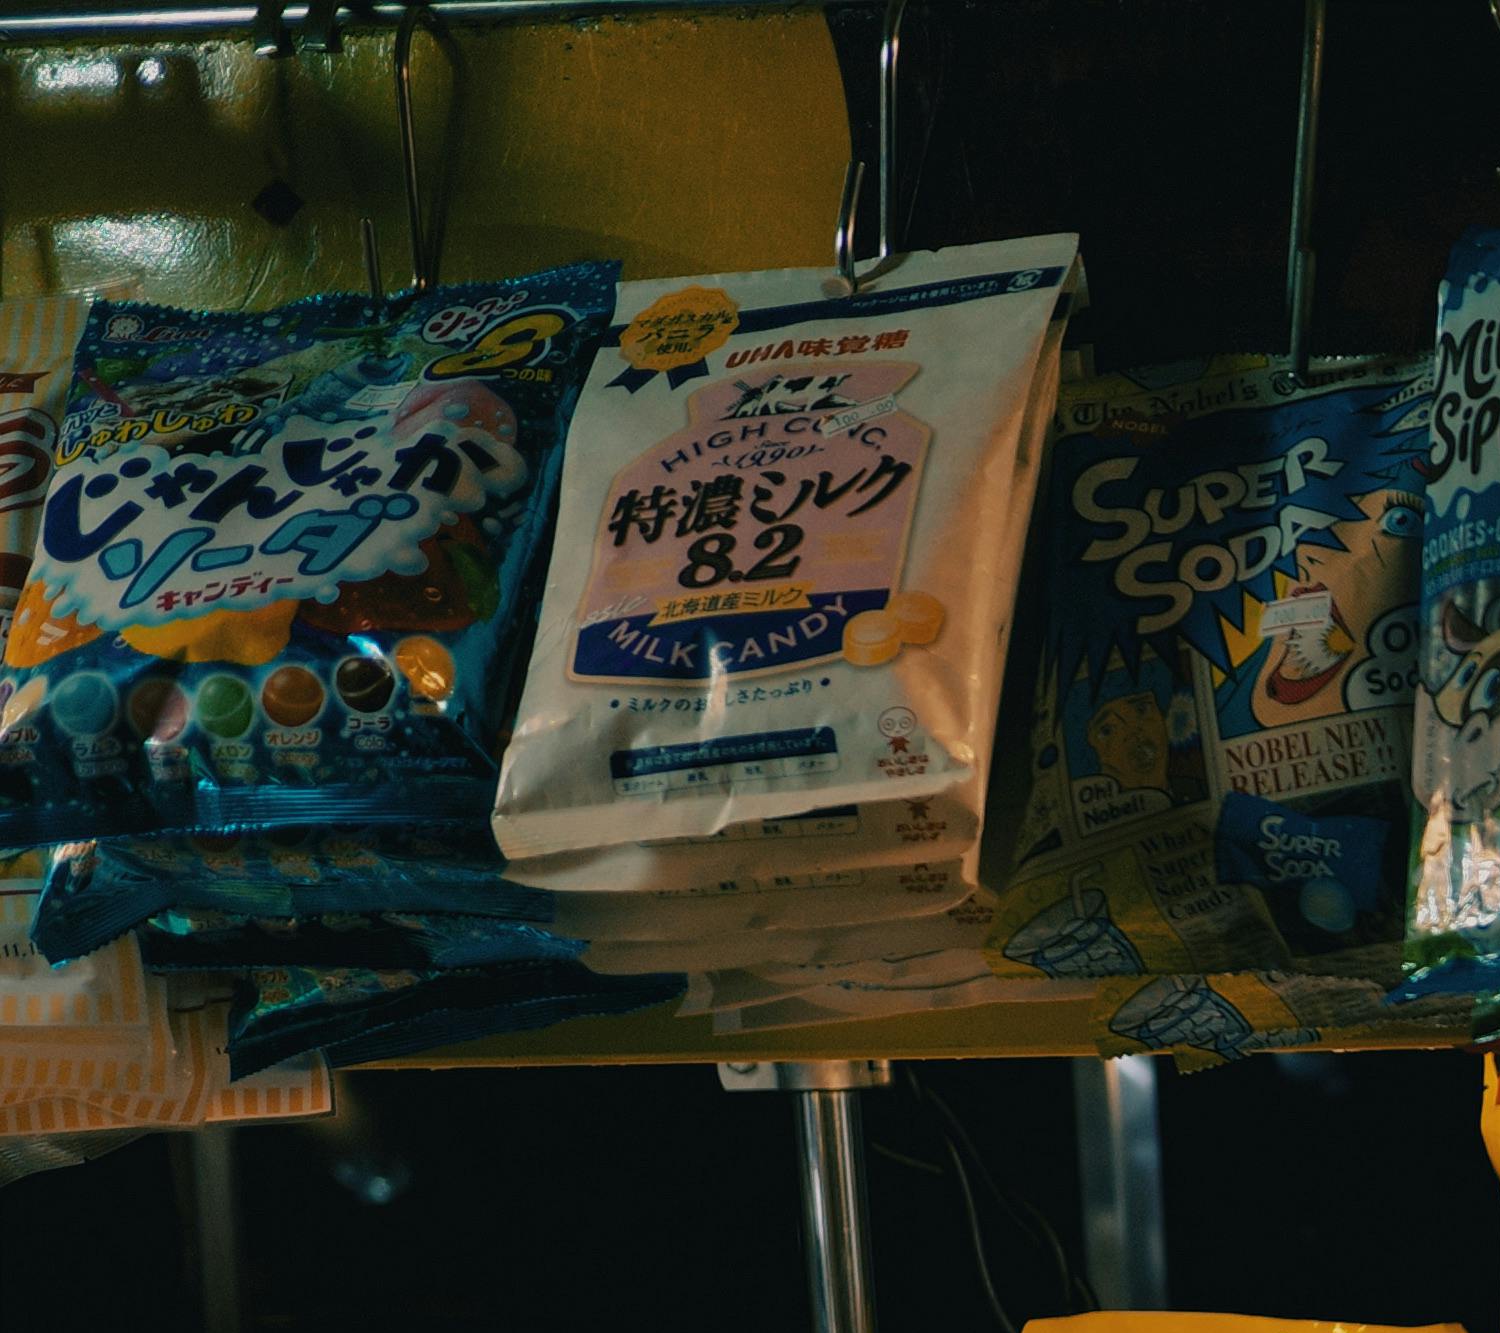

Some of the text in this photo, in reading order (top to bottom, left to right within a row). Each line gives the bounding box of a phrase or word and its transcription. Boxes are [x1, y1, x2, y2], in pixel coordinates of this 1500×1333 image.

[638, 326, 715, 343] バニラ
[725, 330, 911, 369] UHA味覚糖
[54, 402, 261, 466] しゅわしゅわ
[661, 422, 768, 474] HIGH
[1111, 419, 1169, 436] NOBEL
[43, 426, 501, 563] じゃんじゃか
[608, 455, 912, 547] 特濃ミルク
[1072, 437, 1345, 561] SUPER
[99, 493, 419, 608] ソーダ
[678, 524, 804, 589] 8.2
[1114, 503, 1340, 635] SODA
[156, 574, 298, 610] キャンディー
[663, 587, 803, 617] 北海道産ミルク
[608, 594, 850, 668] MILK CANDY
[265, 730, 320, 745] オレンジ
[348, 715, 391, 730] コーラ
[1225, 717, 1388, 773] NOBEL NEW
[1230, 750, 1368, 800] RELEASE
[1258, 814, 1346, 860] SUPER
[1263, 852, 1334, 883] SODA
